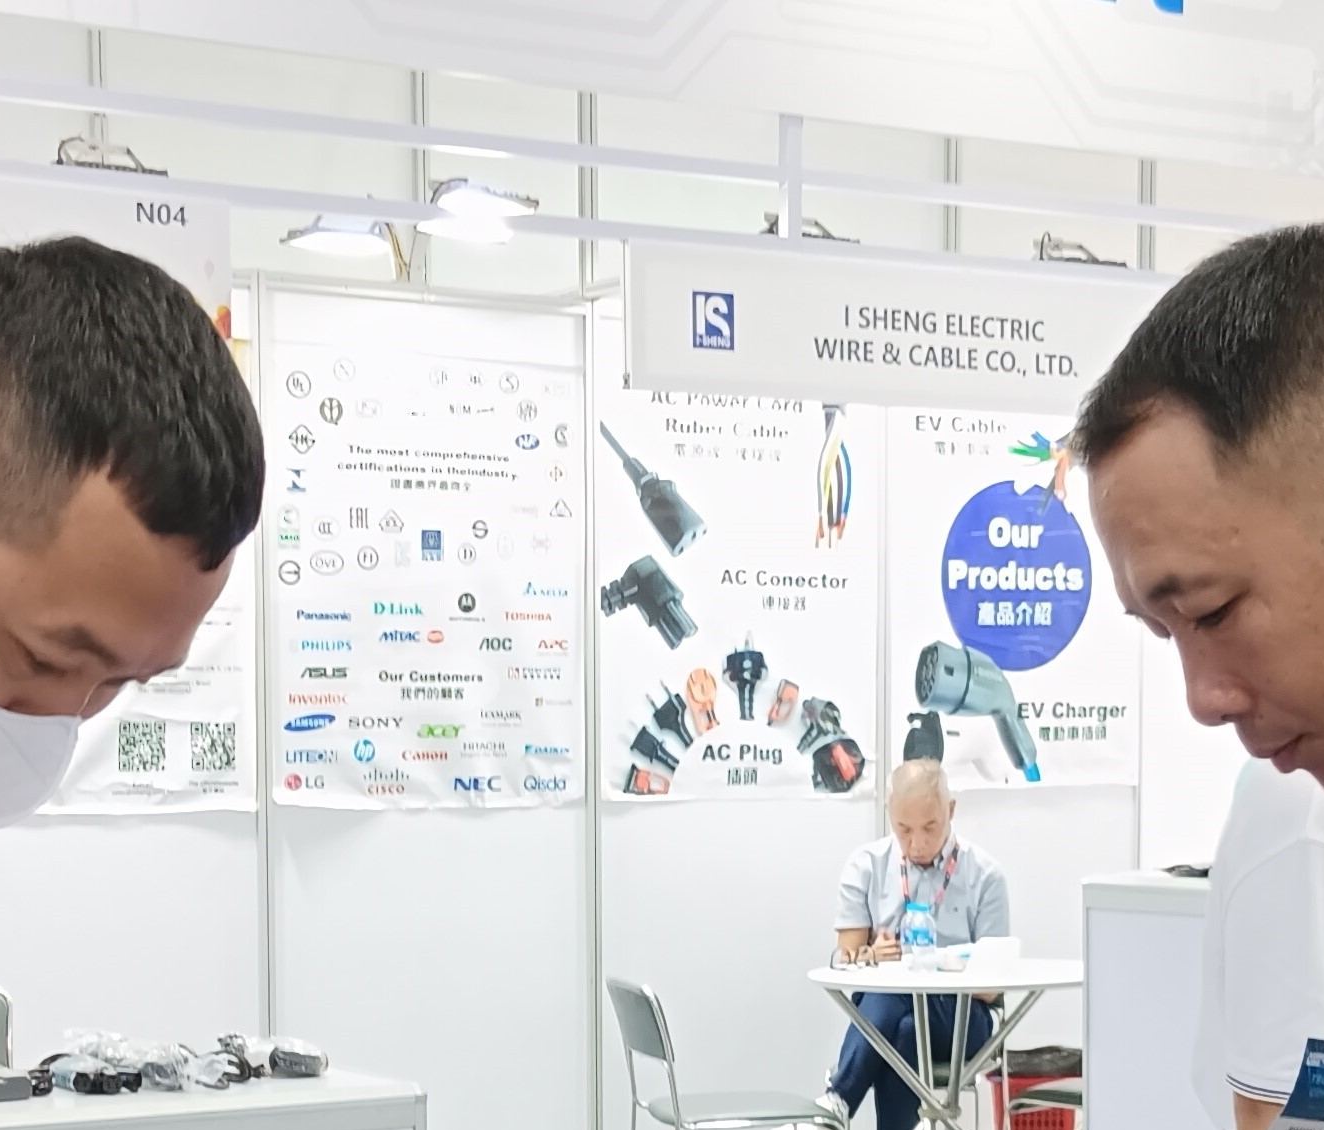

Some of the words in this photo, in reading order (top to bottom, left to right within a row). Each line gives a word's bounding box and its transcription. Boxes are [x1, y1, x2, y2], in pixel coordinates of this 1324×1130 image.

[135, 202, 187, 227] N04
[844, 304, 850, 327] I
[858, 306, 937, 333] SHENG
[945, 314, 1045, 343] ELECTRIC
[814, 337, 875, 363] WIRE
[882, 342, 902, 364] &
[908, 344, 978, 371] CABLE
[985, 349, 1027, 376] CO.,
[1035, 353, 1078, 377] LTD.
[915, 415, 942, 431] EV
[951, 416, 1007, 433] Cable
[414, 450, 509, 463] comprehensive
[337, 462, 426, 474] certifications
[988, 516, 1044, 549] Our
[721, 569, 749, 587] AC
[756, 570, 850, 590] Conector
[947, 560, 1084, 591] Products
[296, 609, 352, 623] Panasonic
[504, 612, 552, 622] TOSHIBA
[977, 602, 1053, 627] 產品介紹
[301, 640, 352, 651] PHILIPS
[301, 667, 349, 679] ASUS
[378, 670, 404, 682] Our
[410, 671, 483, 683] Customers
[1017, 702, 1045, 719] EV
[1052, 702, 1127, 722] Charger
[349, 716, 402, 729] SONY
[402, 750, 448, 761] Canon
[702, 744, 732, 762] AC
[740, 744, 783, 764] Plug
[306, 775, 325, 789] LG
[454, 777, 502, 792] NEC
[523, 776, 567, 792] Qisda
